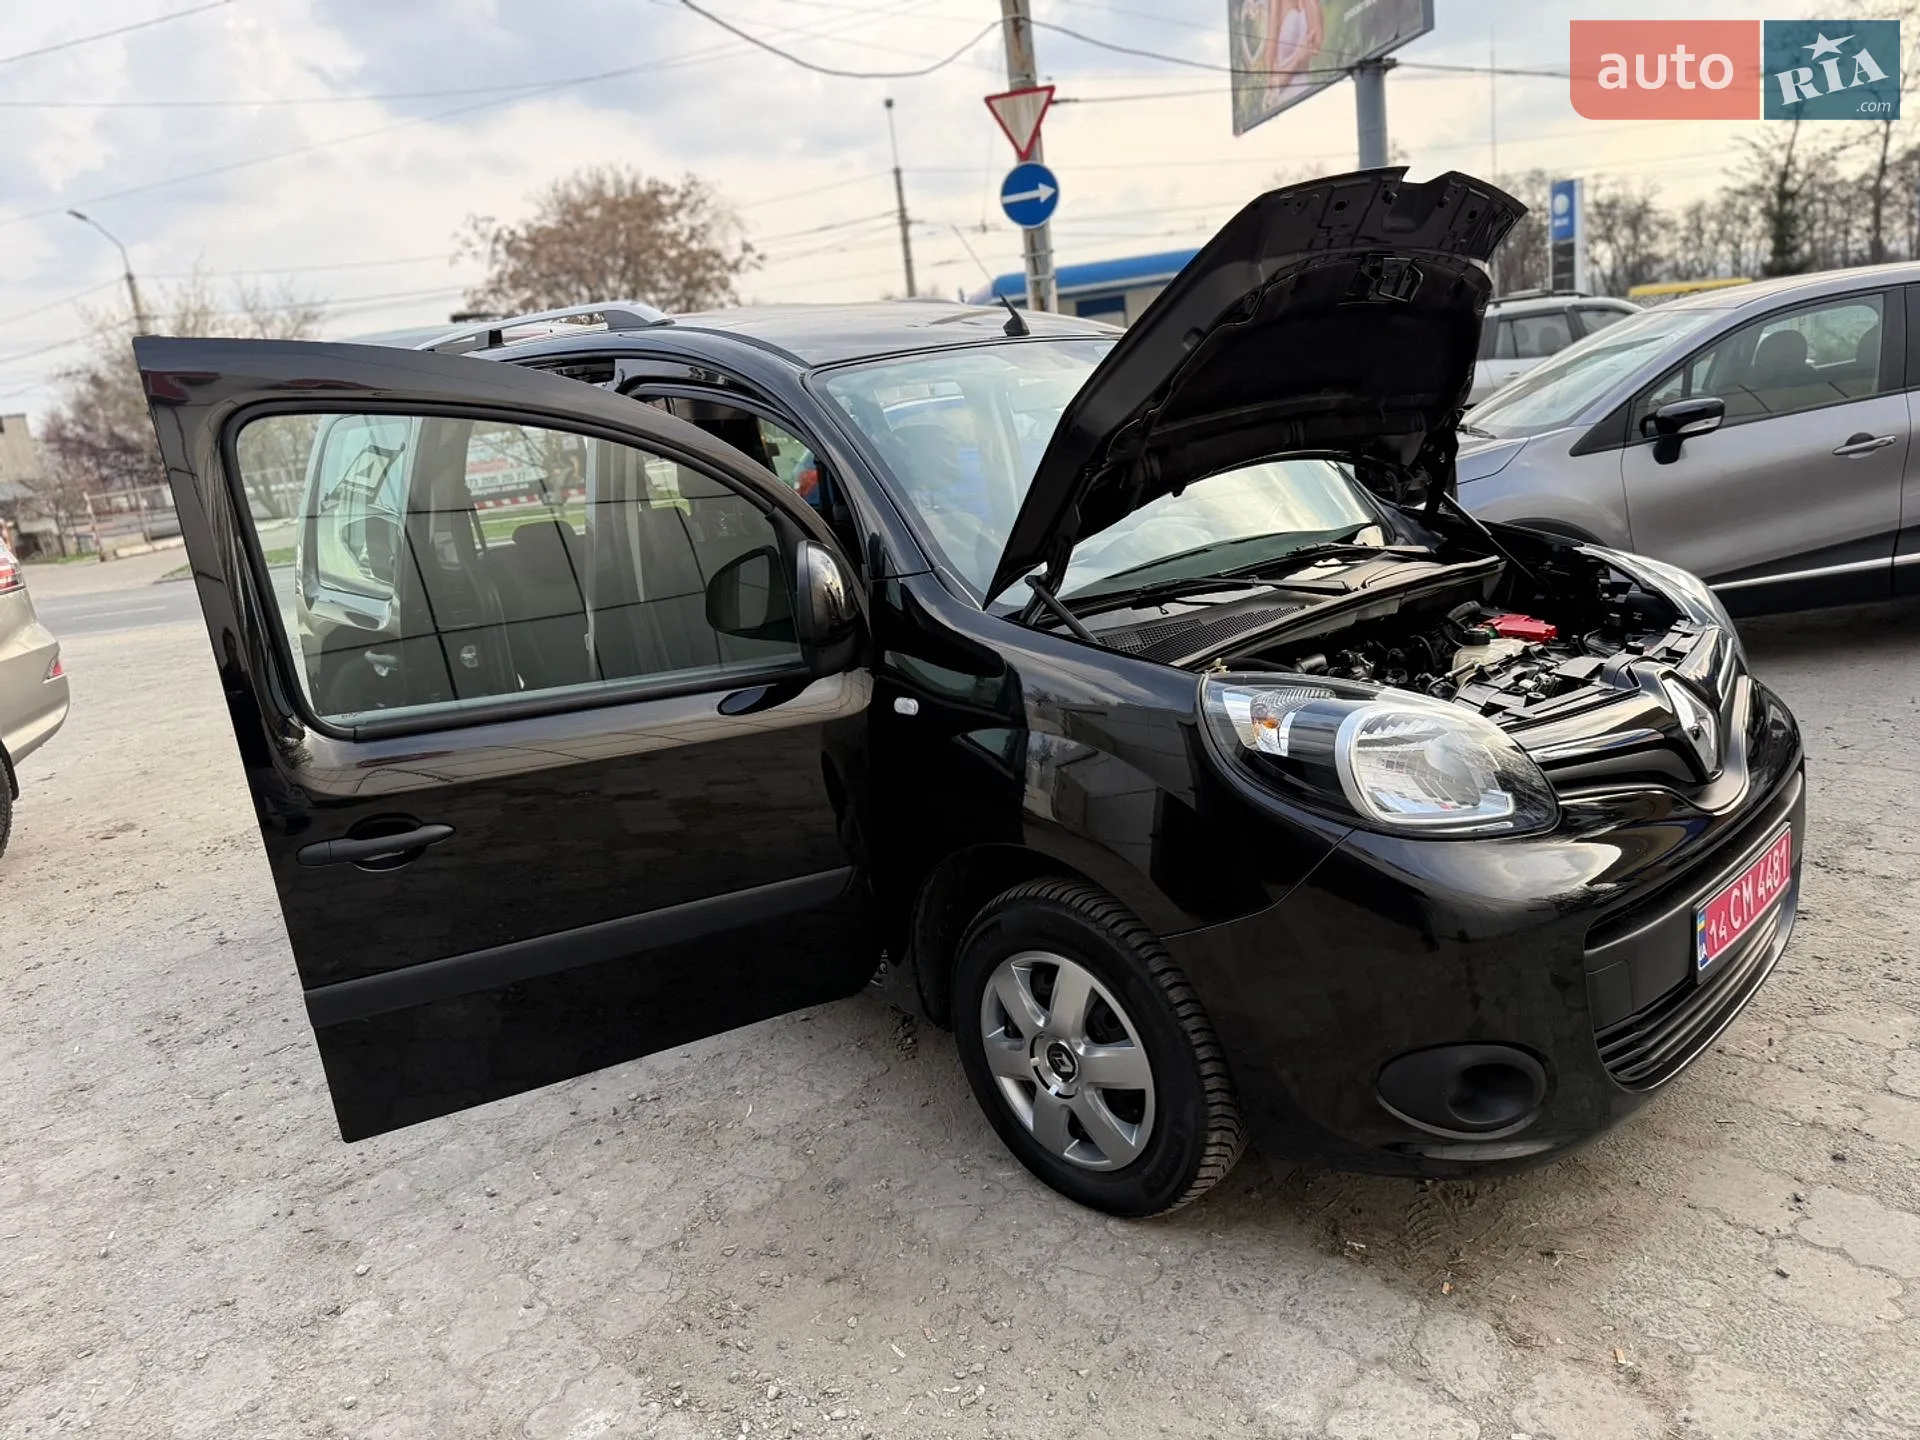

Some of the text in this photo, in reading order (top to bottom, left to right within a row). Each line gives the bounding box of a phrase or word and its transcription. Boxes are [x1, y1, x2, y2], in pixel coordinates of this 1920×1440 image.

[1709, 839, 1788, 949] 14 CM 4481
